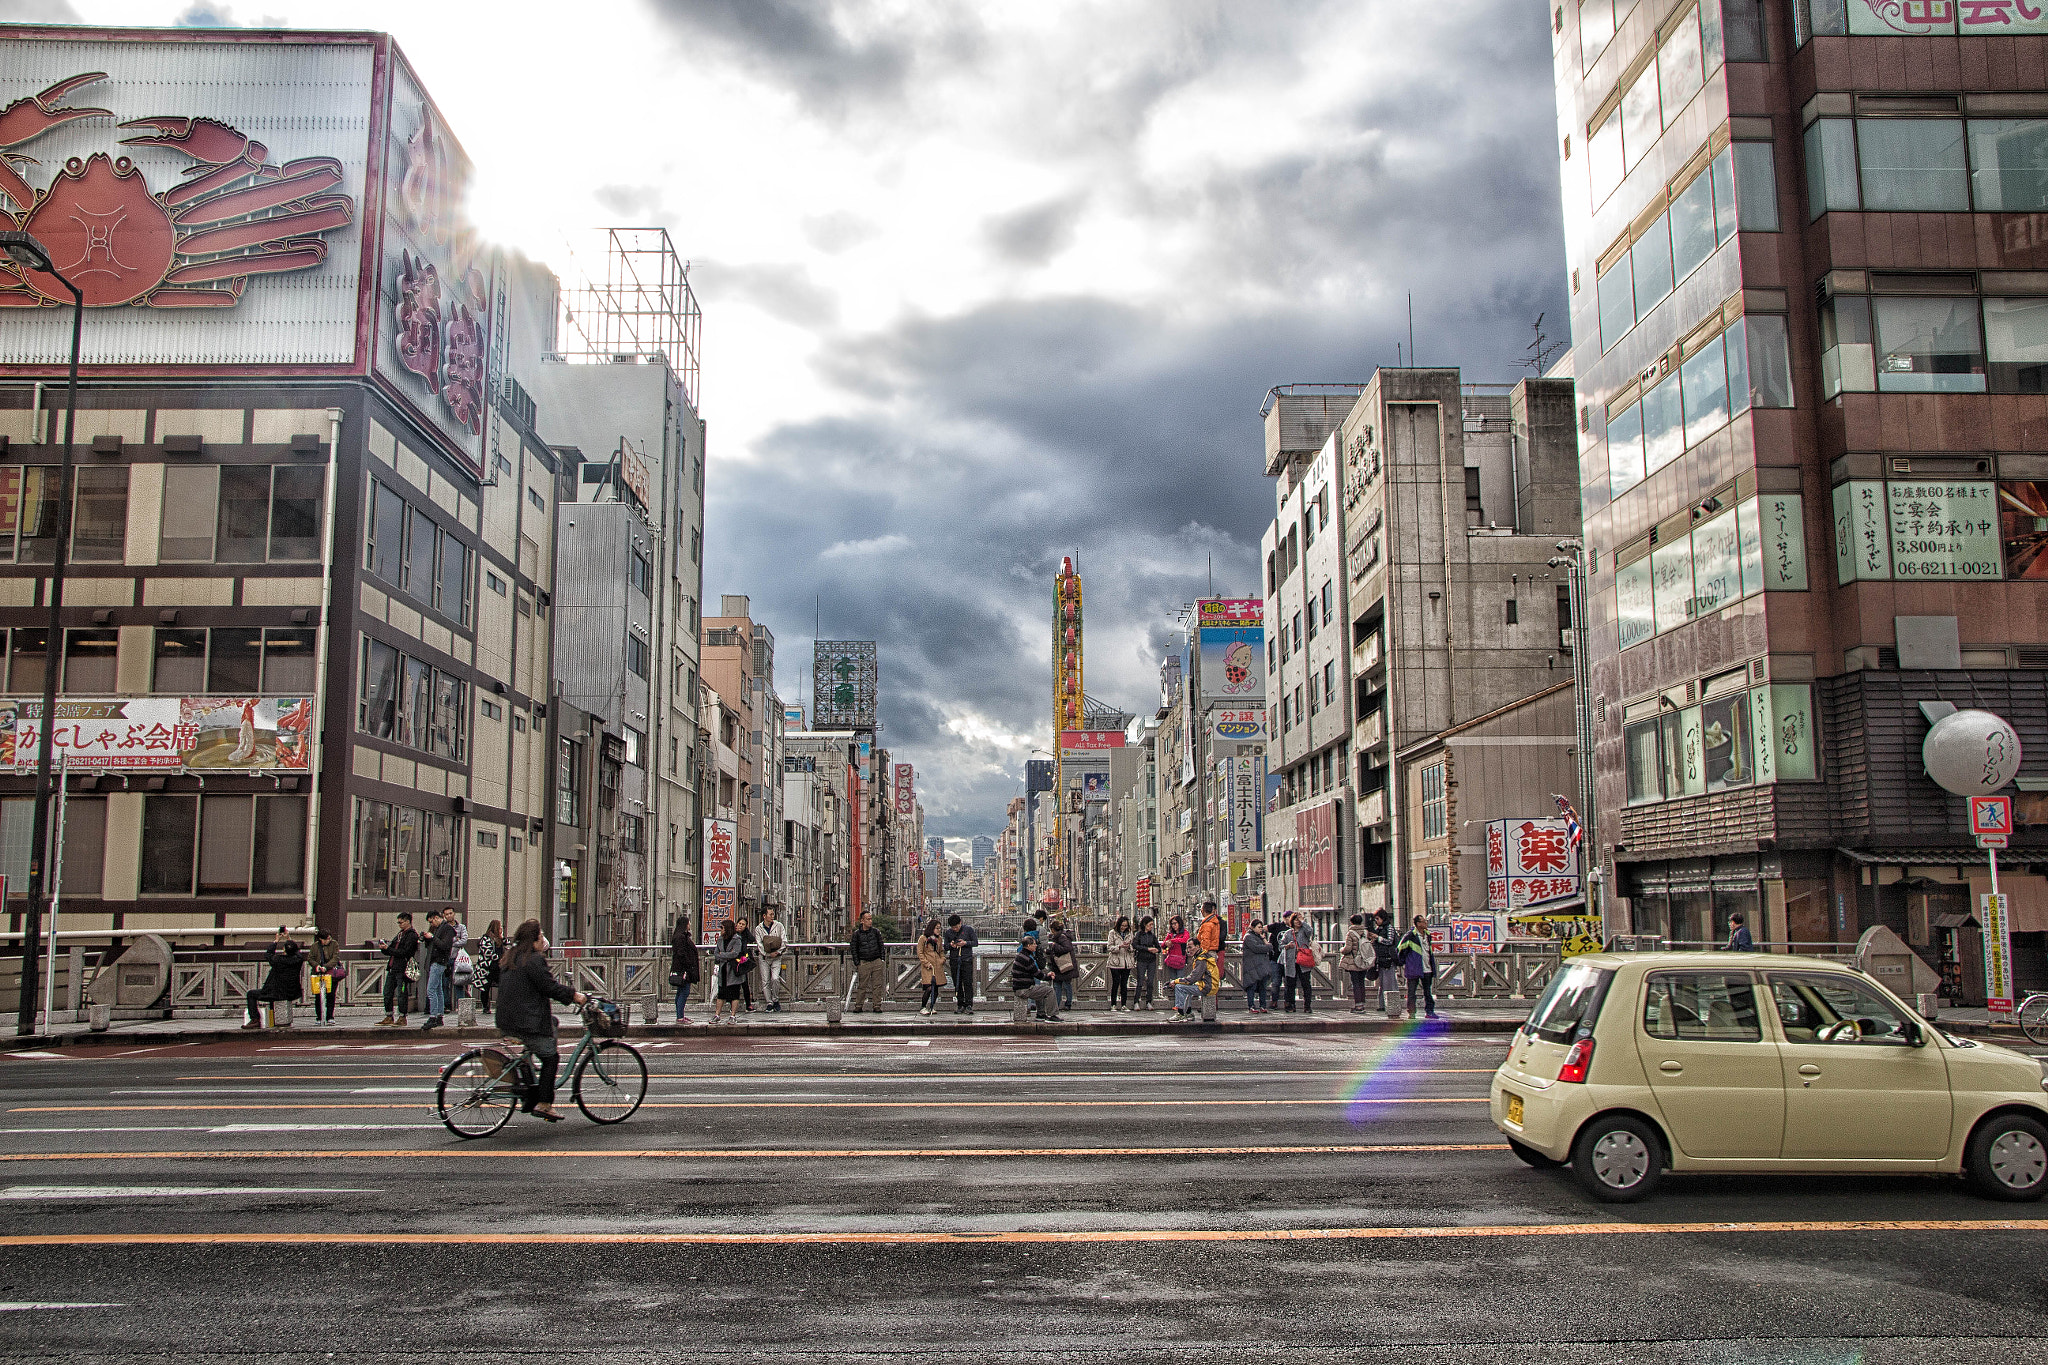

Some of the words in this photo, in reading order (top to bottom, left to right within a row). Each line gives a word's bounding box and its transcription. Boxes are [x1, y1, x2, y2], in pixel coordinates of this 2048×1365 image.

[1891, 486, 1990, 499] お座敷60名様まで
[1893, 501, 1942, 518] ご宴会
[1894, 519, 1991, 537] ご予約承り中
[1896, 540, 1963, 554] 3,800円より
[1897, 561, 2000, 576] 06-6211-0021
[26, 704, 117, 718] 特会席フェア
[1219, 723, 1258, 733] マンション
[1520, 829, 1567, 872] 薬
[705, 888, 735, 906] ダイコク
[1528, 879, 1573, 903] 免税
